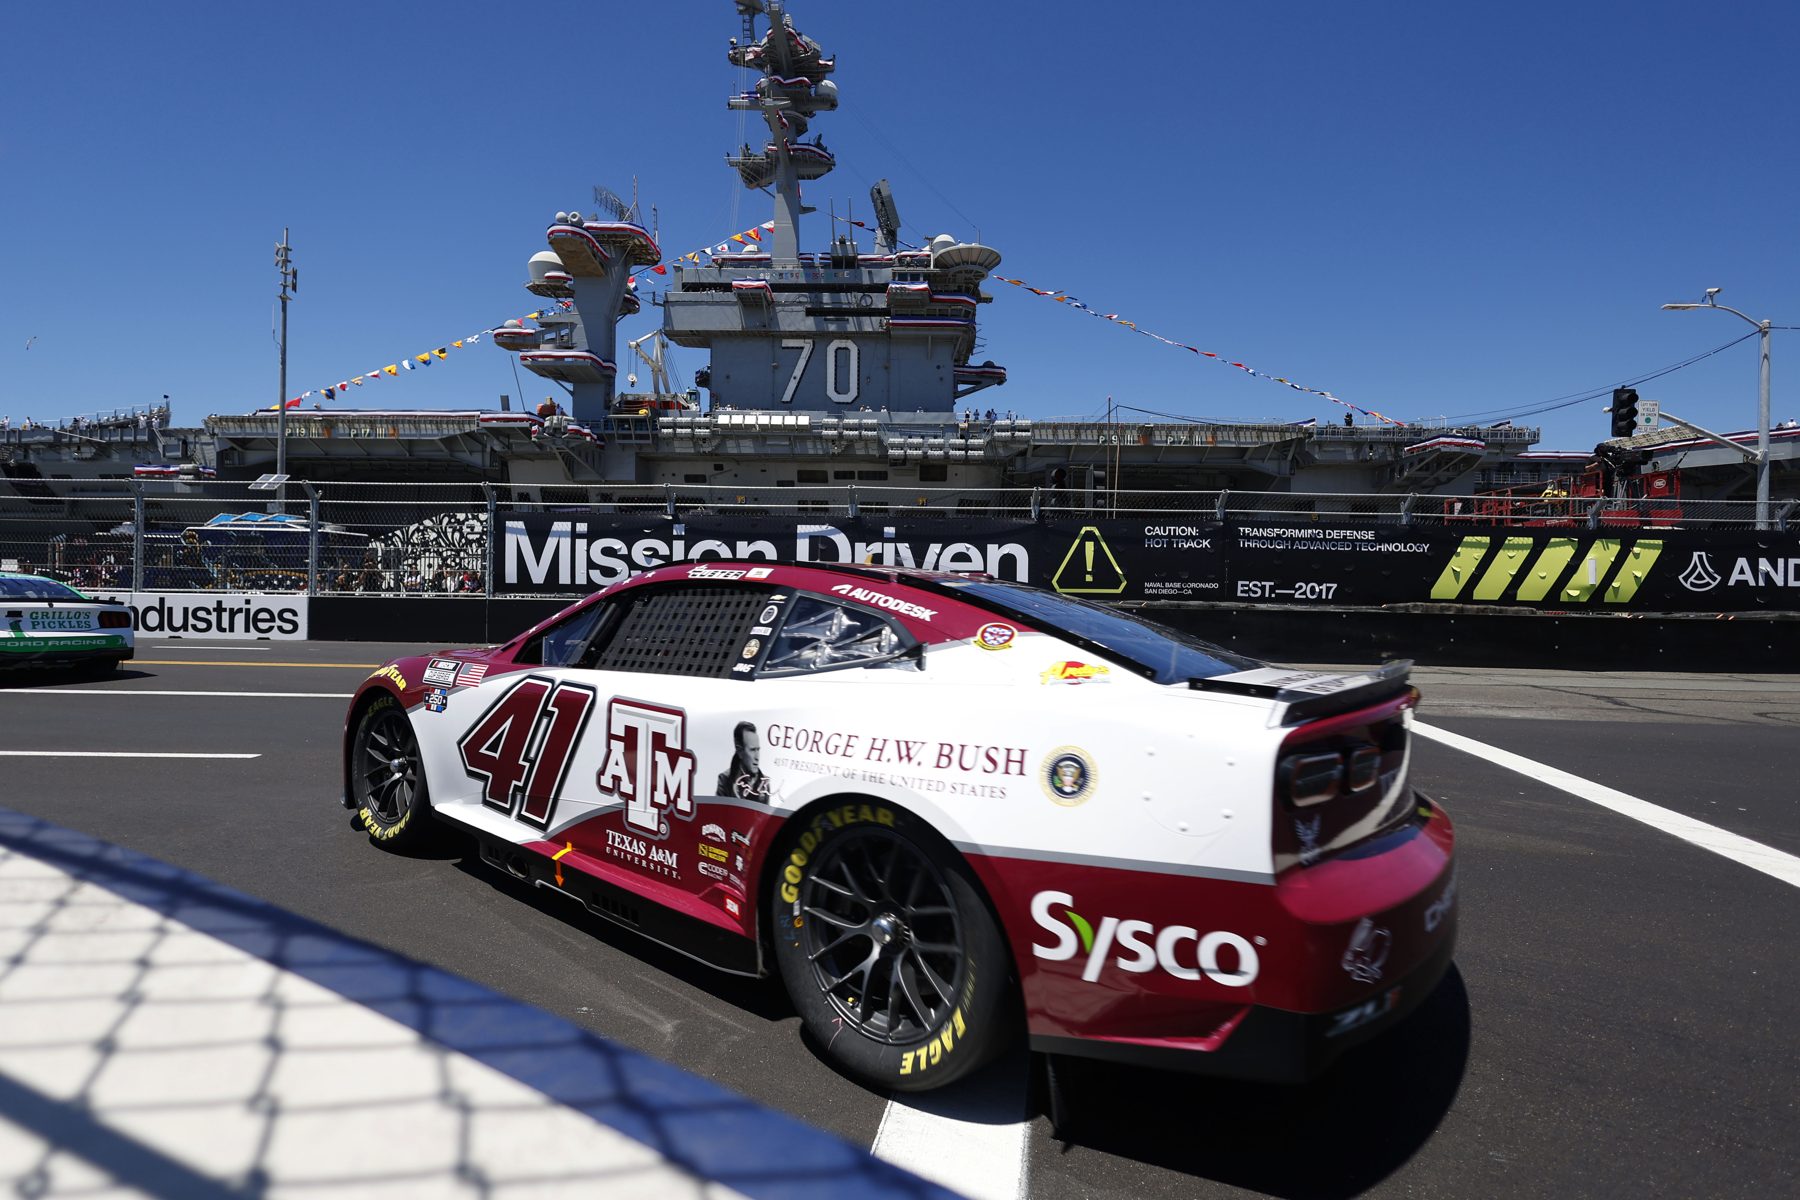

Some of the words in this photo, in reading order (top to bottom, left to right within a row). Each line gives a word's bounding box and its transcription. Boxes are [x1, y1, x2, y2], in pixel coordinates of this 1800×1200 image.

[781, 339, 860, 403] 70
[1144, 526, 1199, 536] CAUTION:
[1238, 527, 1324, 539] TRANSFORMING
[1325, 529, 1376, 540] DEFENSE
[1144, 538, 1169, 548] HOT
[1173, 539, 1211, 549] TRACK
[1238, 539, 1291, 549] THROUGH
[1293, 540, 1352, 551] ADVANCED
[1354, 541, 1430, 553] TECHNOLOGY
[29, 611, 91, 620] GRILLO'S
[848, 587, 938, 622] AUTODESK
[31, 620, 92, 629] PICKLES
[48, 639, 106, 647] RACING
[429, 694, 443, 705] 250
[457, 675, 597, 832] 41
[767, 723, 859, 758] GEORGE
[864, 737, 927, 767] H.W.
[933, 742, 1029, 776] BUSH
[791, 759, 840, 777] PRESIDENT
[842, 767, 858, 780] OF
[861, 770, 886, 785] THE
[889, 774, 946, 793] UNITED
[949, 781, 1007, 799] STATES
[606, 829, 647, 857] TEXAS
[648, 845, 679, 868] A&M
[780, 804, 896, 903] GOODYEAR
[899, 1009, 967, 1075] EAGLE
